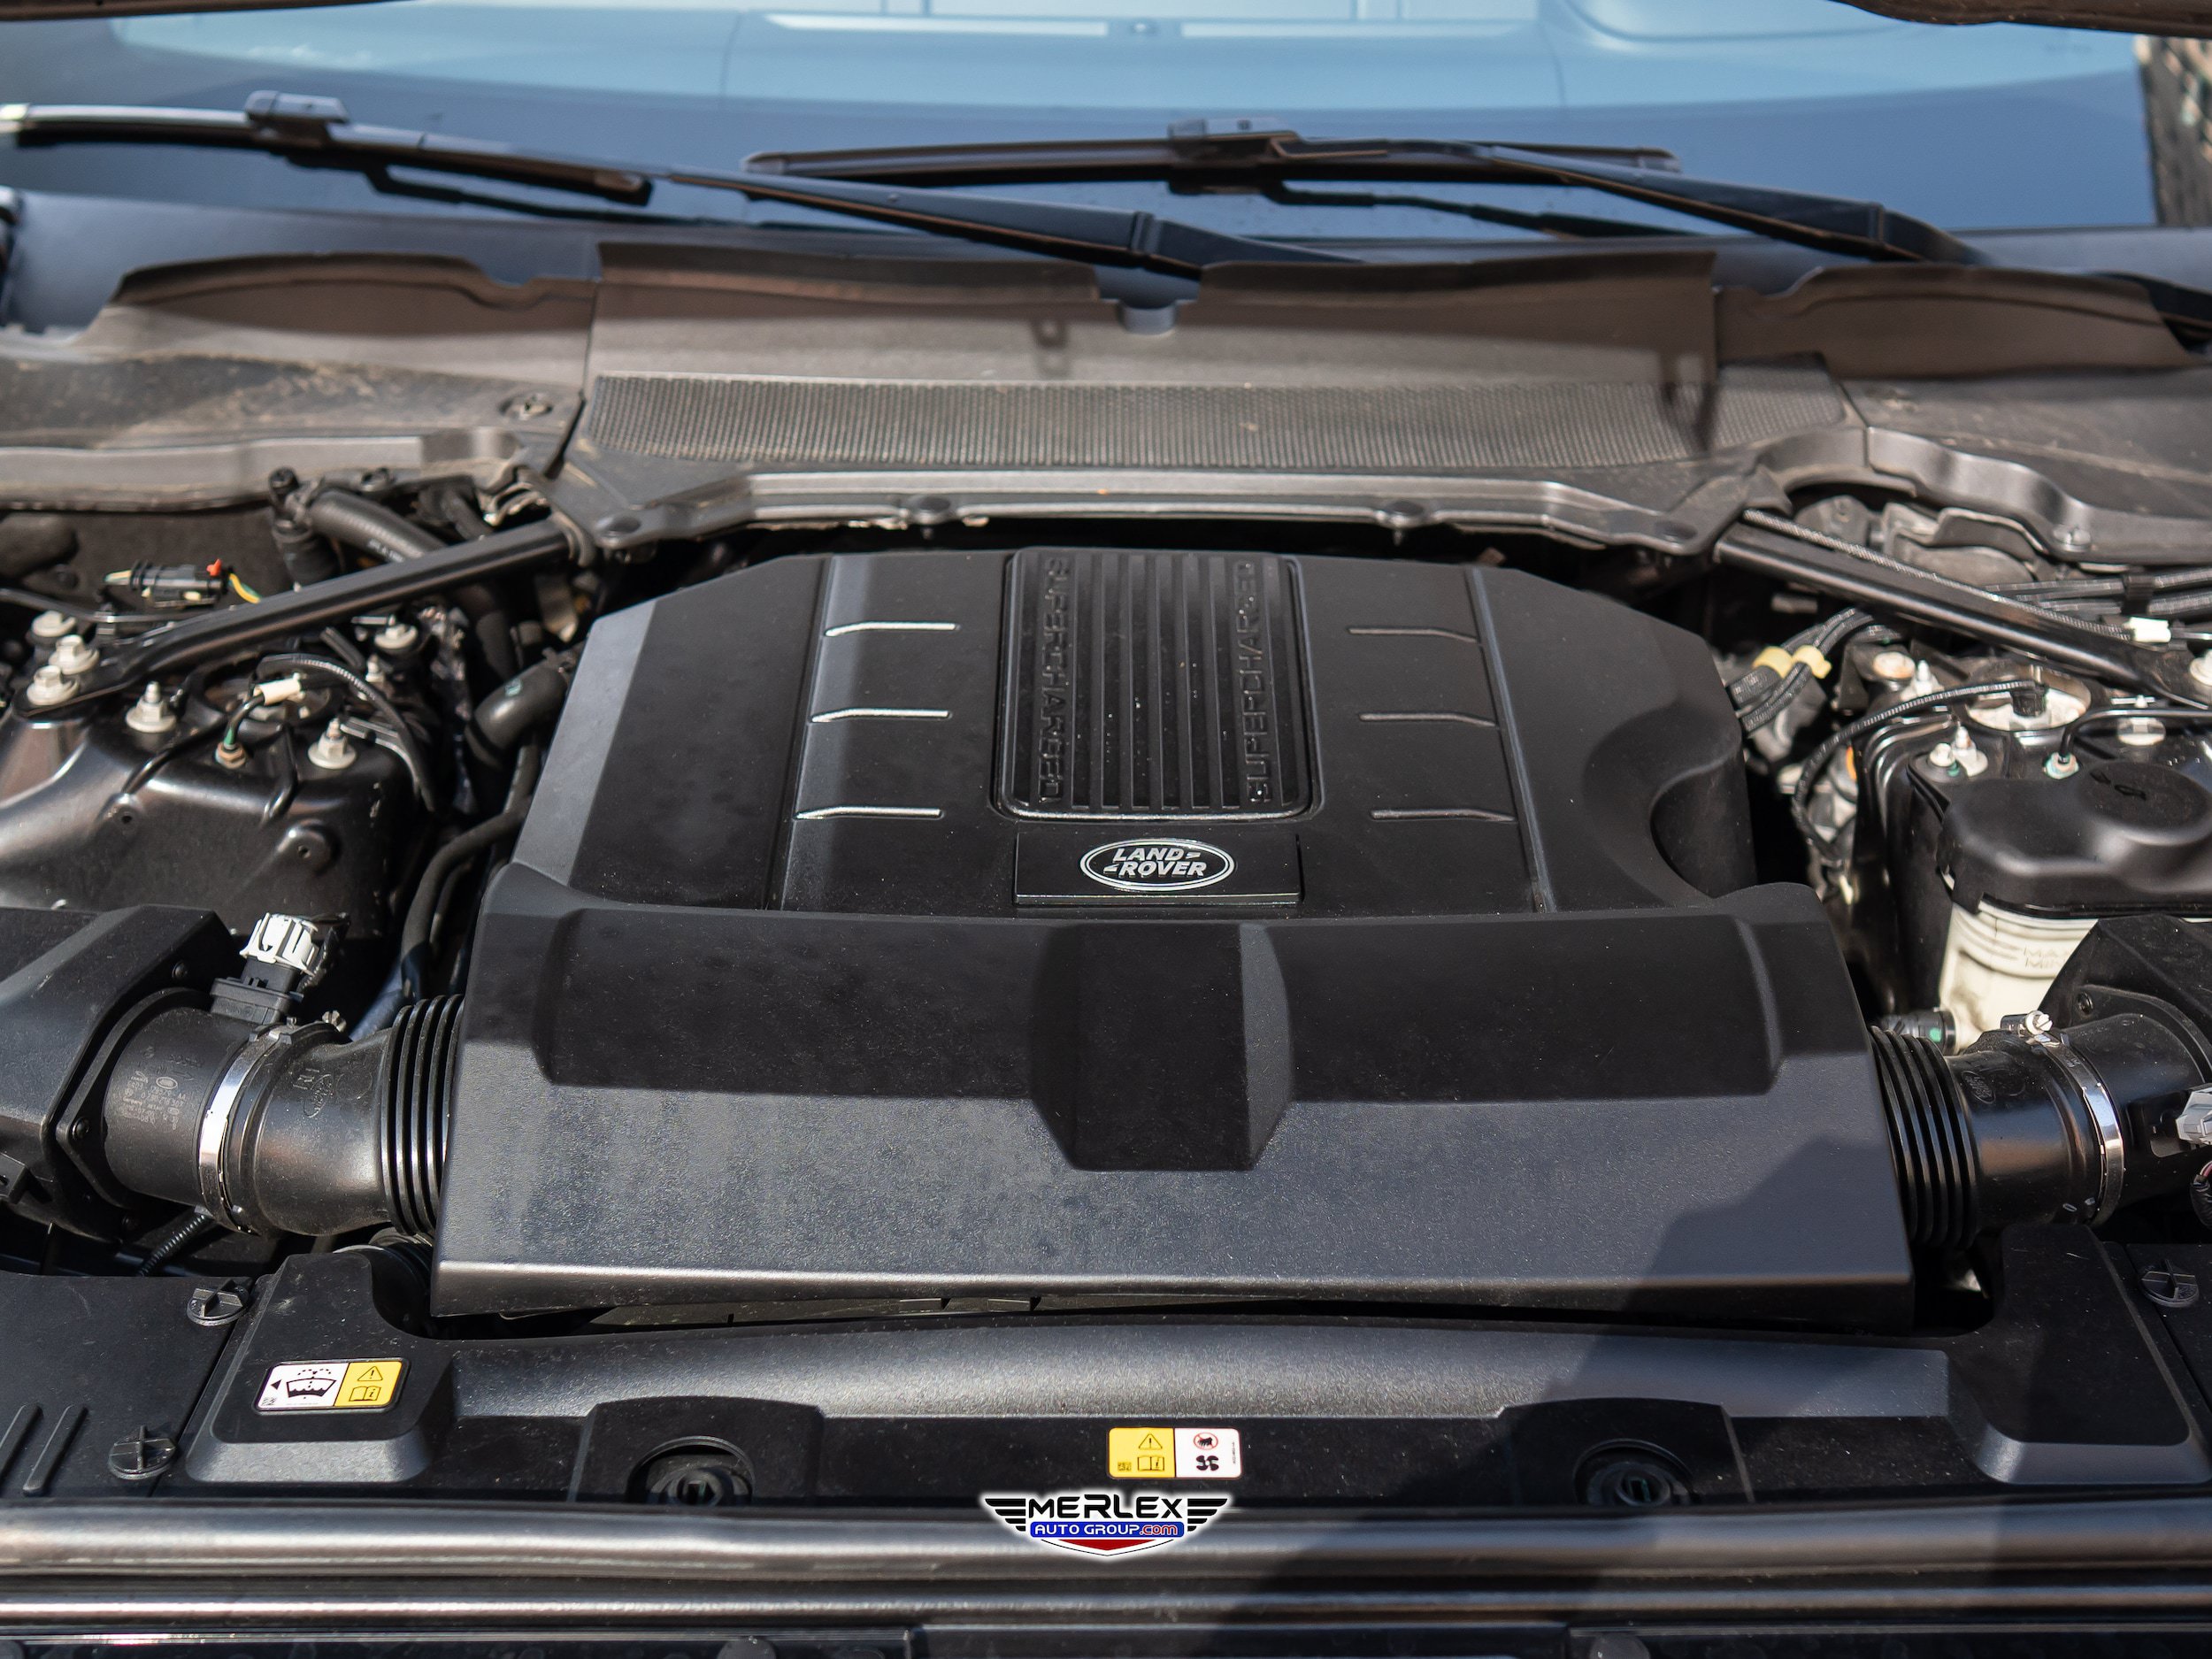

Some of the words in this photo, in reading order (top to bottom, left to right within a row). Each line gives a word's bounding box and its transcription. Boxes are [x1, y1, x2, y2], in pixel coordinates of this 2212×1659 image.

[1039, 558, 1070, 803] SUPERCHARGED
[1233, 560, 1273, 803] SUPERCHARGED
[1112, 847, 1185, 862] LAND
[1118, 861, 1207, 877] ROVER
